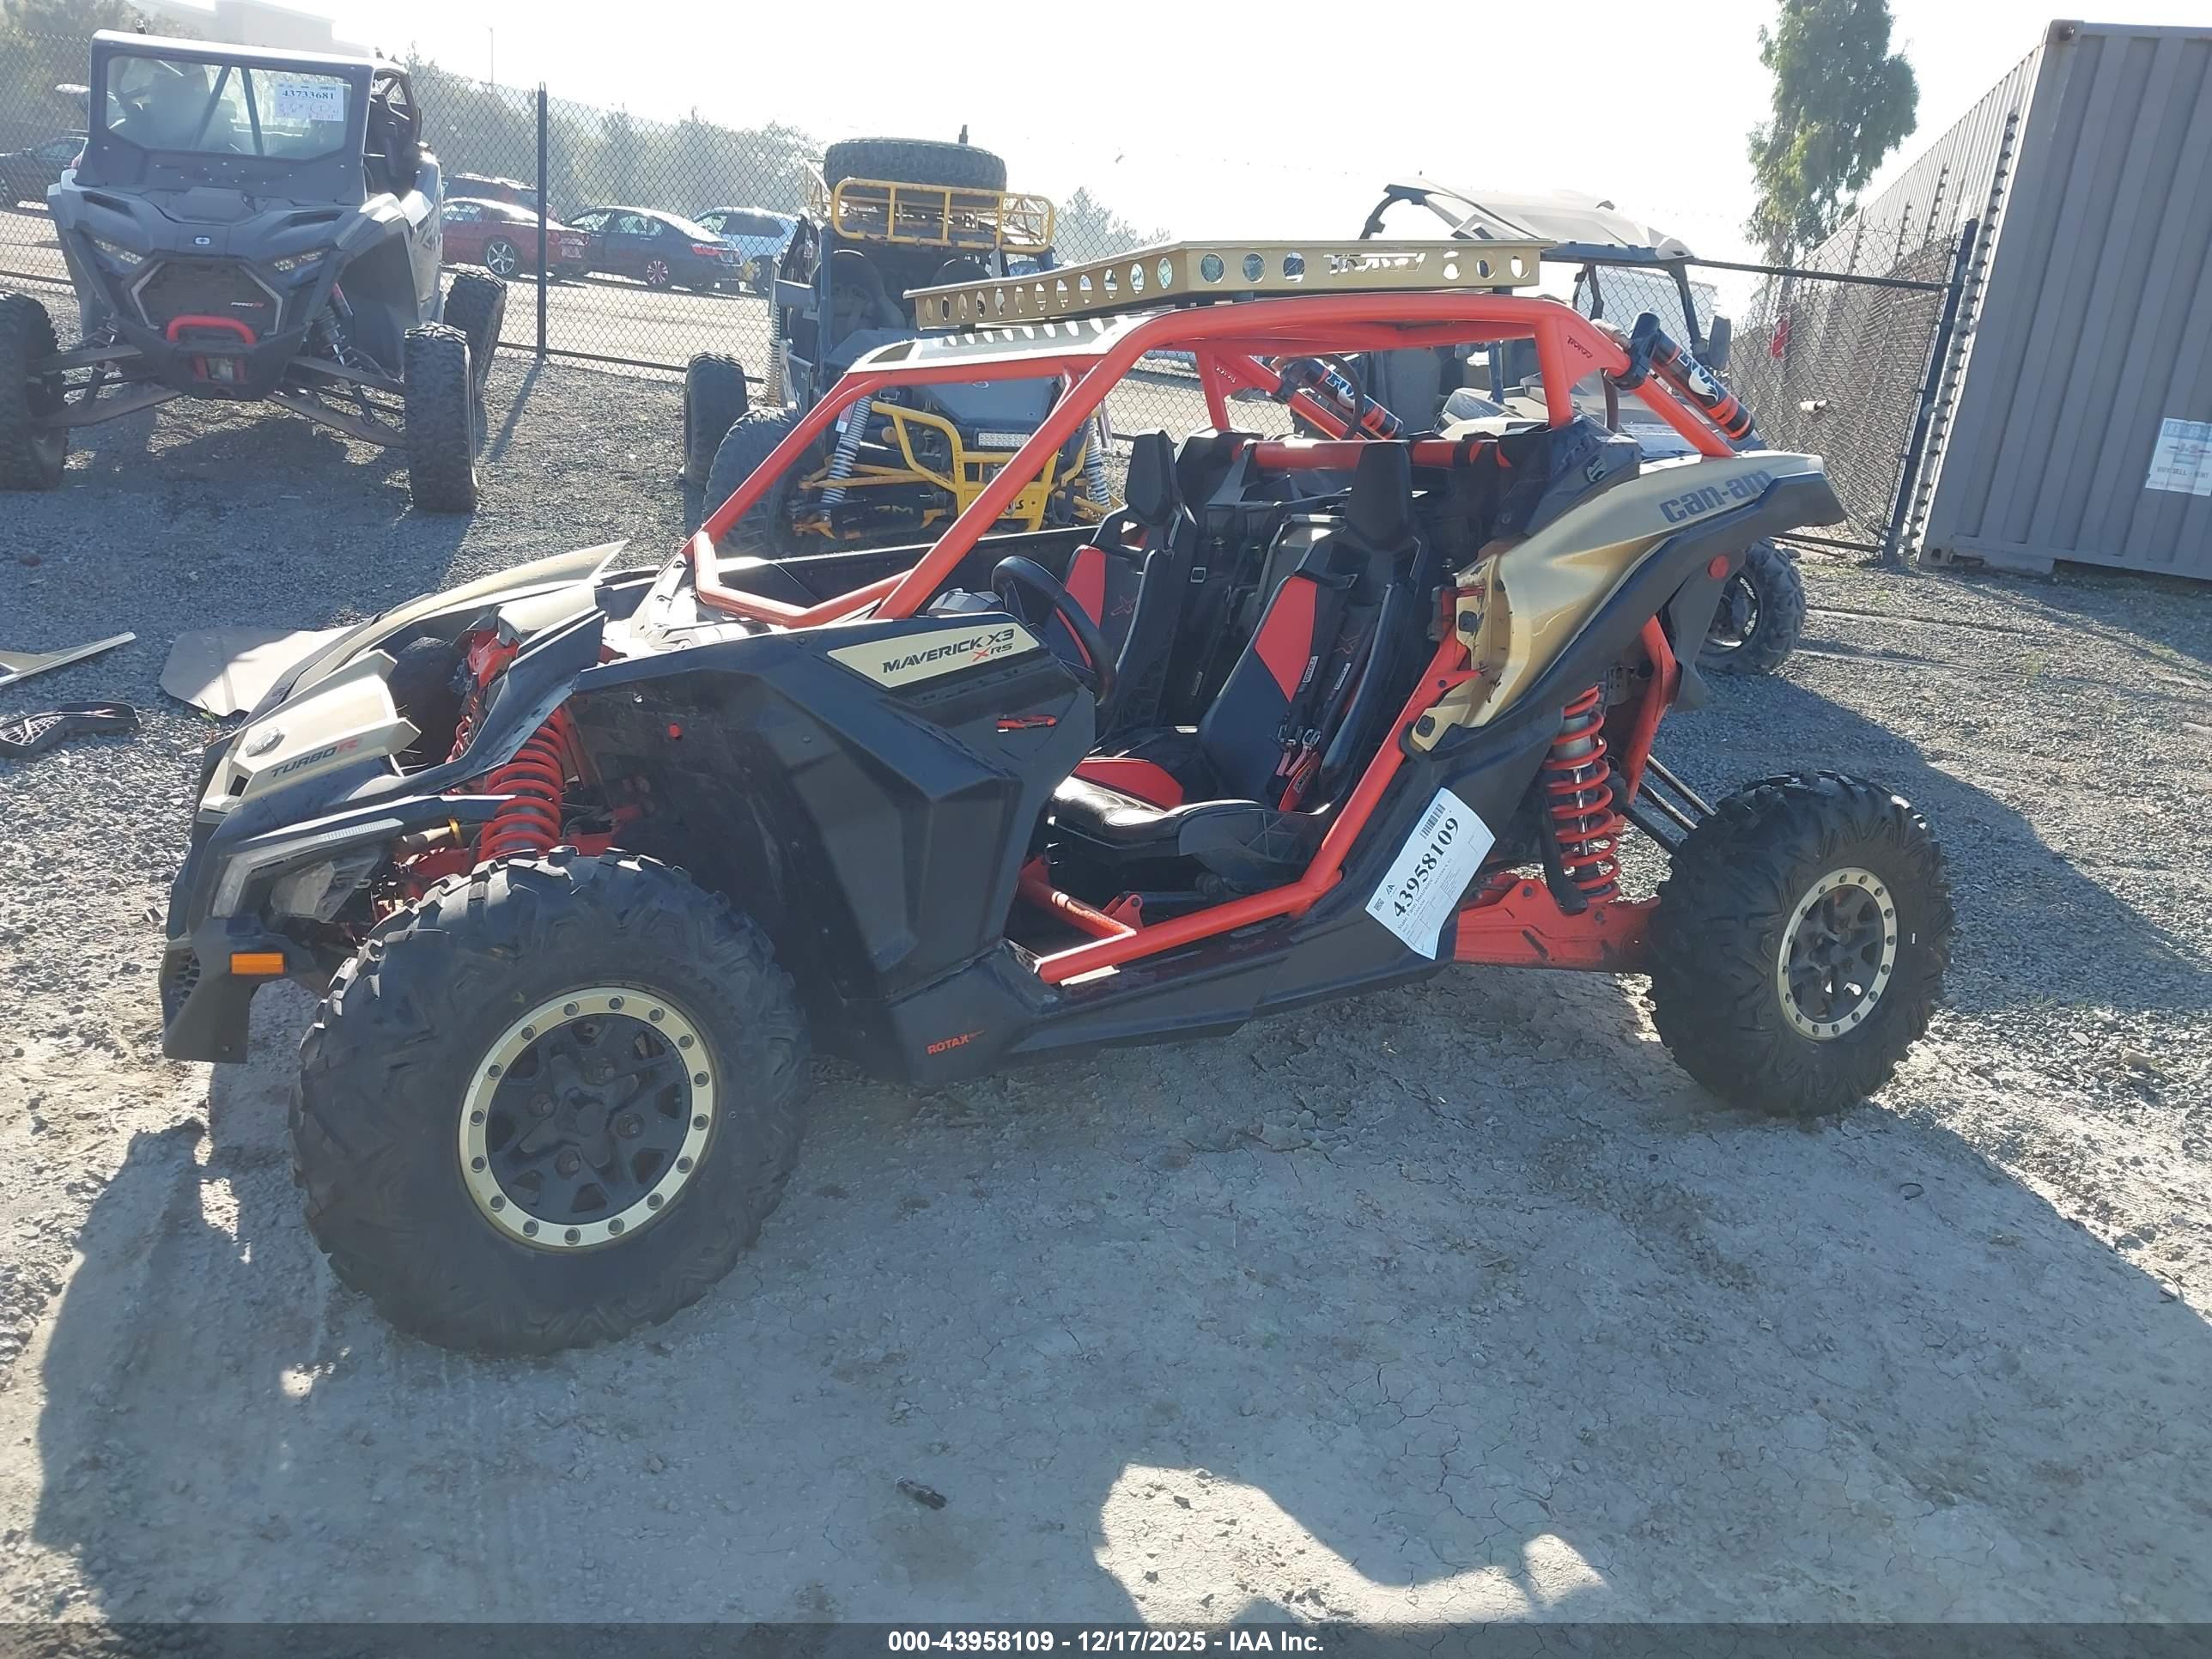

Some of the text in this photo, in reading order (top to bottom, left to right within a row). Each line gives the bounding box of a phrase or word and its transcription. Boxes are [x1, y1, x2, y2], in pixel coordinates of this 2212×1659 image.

[282, 89, 334, 100] 43733681
[1659, 470, 1774, 515] can-am
[882, 628, 1015, 674] MAVERICK X3
[1393, 817, 1459, 918] 43958109
[927, 1033, 969, 1055] ROTAX
